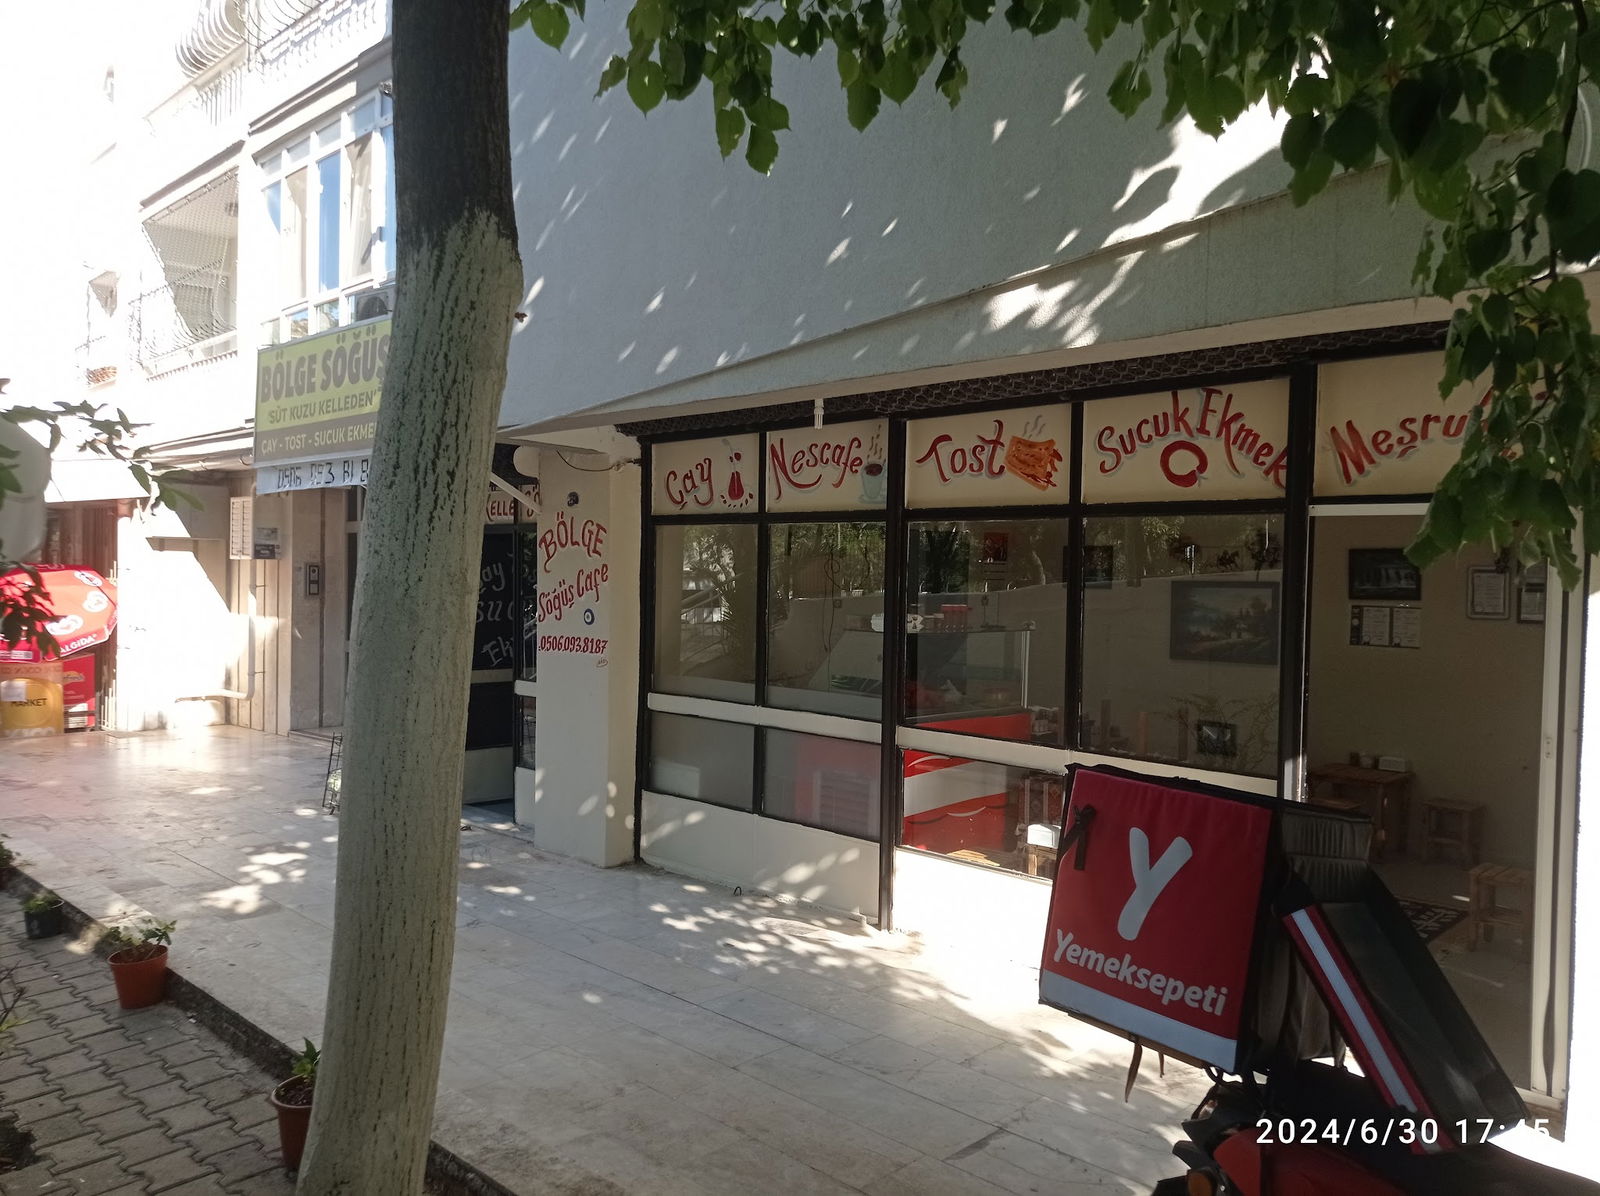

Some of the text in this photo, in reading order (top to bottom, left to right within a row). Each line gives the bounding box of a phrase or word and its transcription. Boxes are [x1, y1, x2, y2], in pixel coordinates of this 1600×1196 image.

[260, 351, 317, 403] BÖLGE
[261, 440, 278, 455] ÇAY
[284, 434, 307, 450] TOST
[314, 427, 345, 447] SUCUK
[290, 405, 317, 420] KUZU
[1097, 389, 1195, 475] Sucuk
[1329, 386, 1517, 485] Meşru
[769, 436, 864, 501] Nescafe
[915, 419, 1006, 484] Tost
[665, 457, 714, 511] Çay
[538, 511, 607, 573] BÖLGE
[576, 563, 609, 603] Cafe
[1117, 827, 1193, 941] Y
[1053, 928, 1228, 1017] Yemeksepeti
